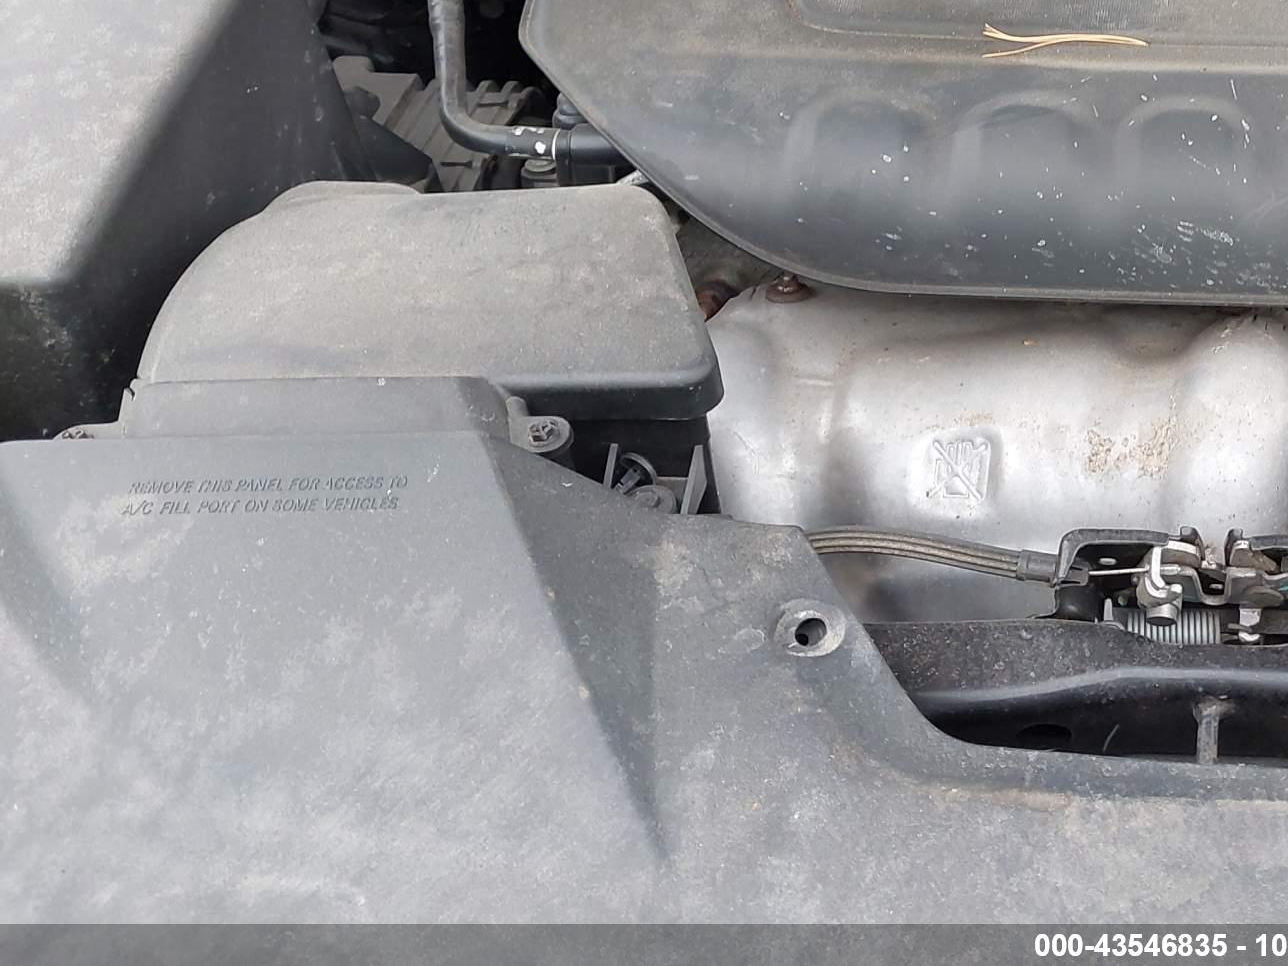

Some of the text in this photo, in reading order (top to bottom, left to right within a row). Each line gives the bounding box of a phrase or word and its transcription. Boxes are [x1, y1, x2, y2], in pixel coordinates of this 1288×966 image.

[128, 475, 408, 495] REMOVE THIS PANEL FOR ACCESS TO
[122, 497, 400, 516] A/C FILL PORT ON SOME VEHICLES
